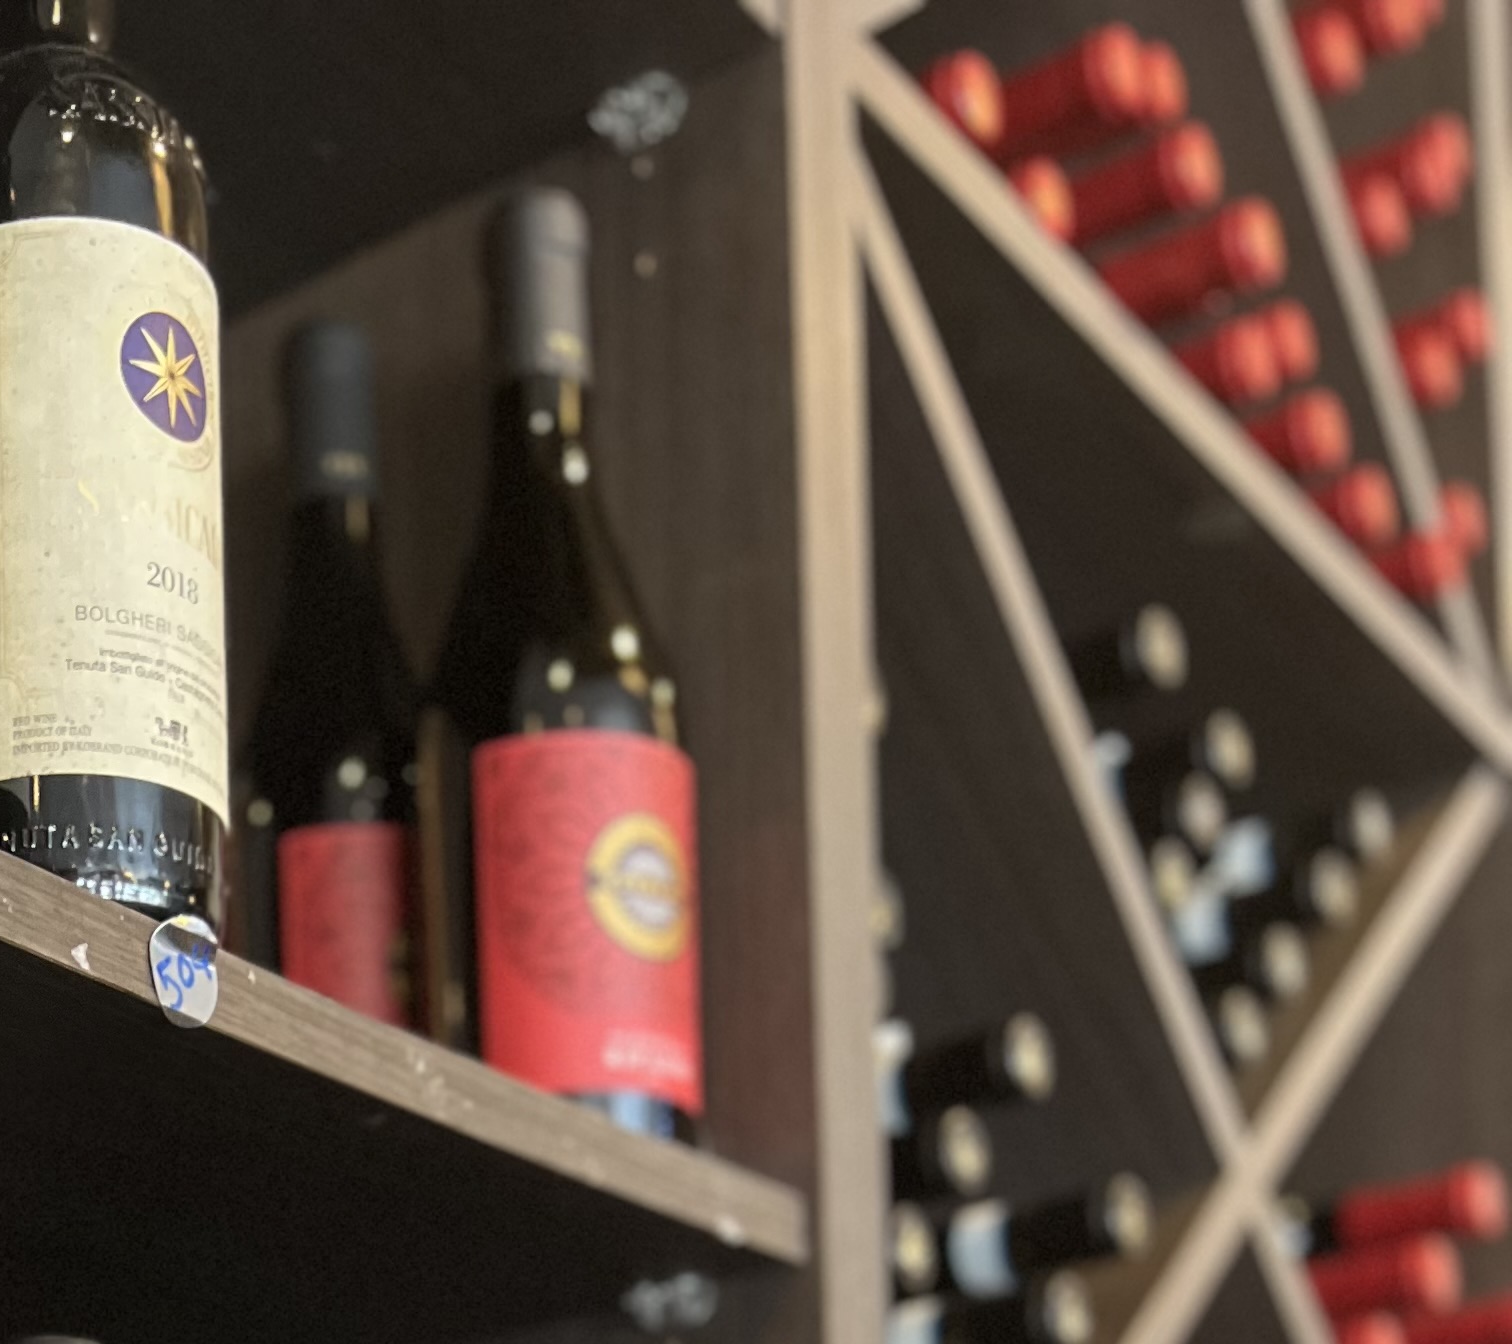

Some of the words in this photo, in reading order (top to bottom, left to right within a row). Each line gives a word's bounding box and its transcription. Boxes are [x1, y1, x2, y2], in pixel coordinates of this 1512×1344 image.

[146, 560, 199, 605] 2018
[75, 604, 172, 635] BOLGHERI
[65, 658, 106, 676] Tenuta
[110, 661, 133, 677] San
[156, 942, 213, 1012] 504
